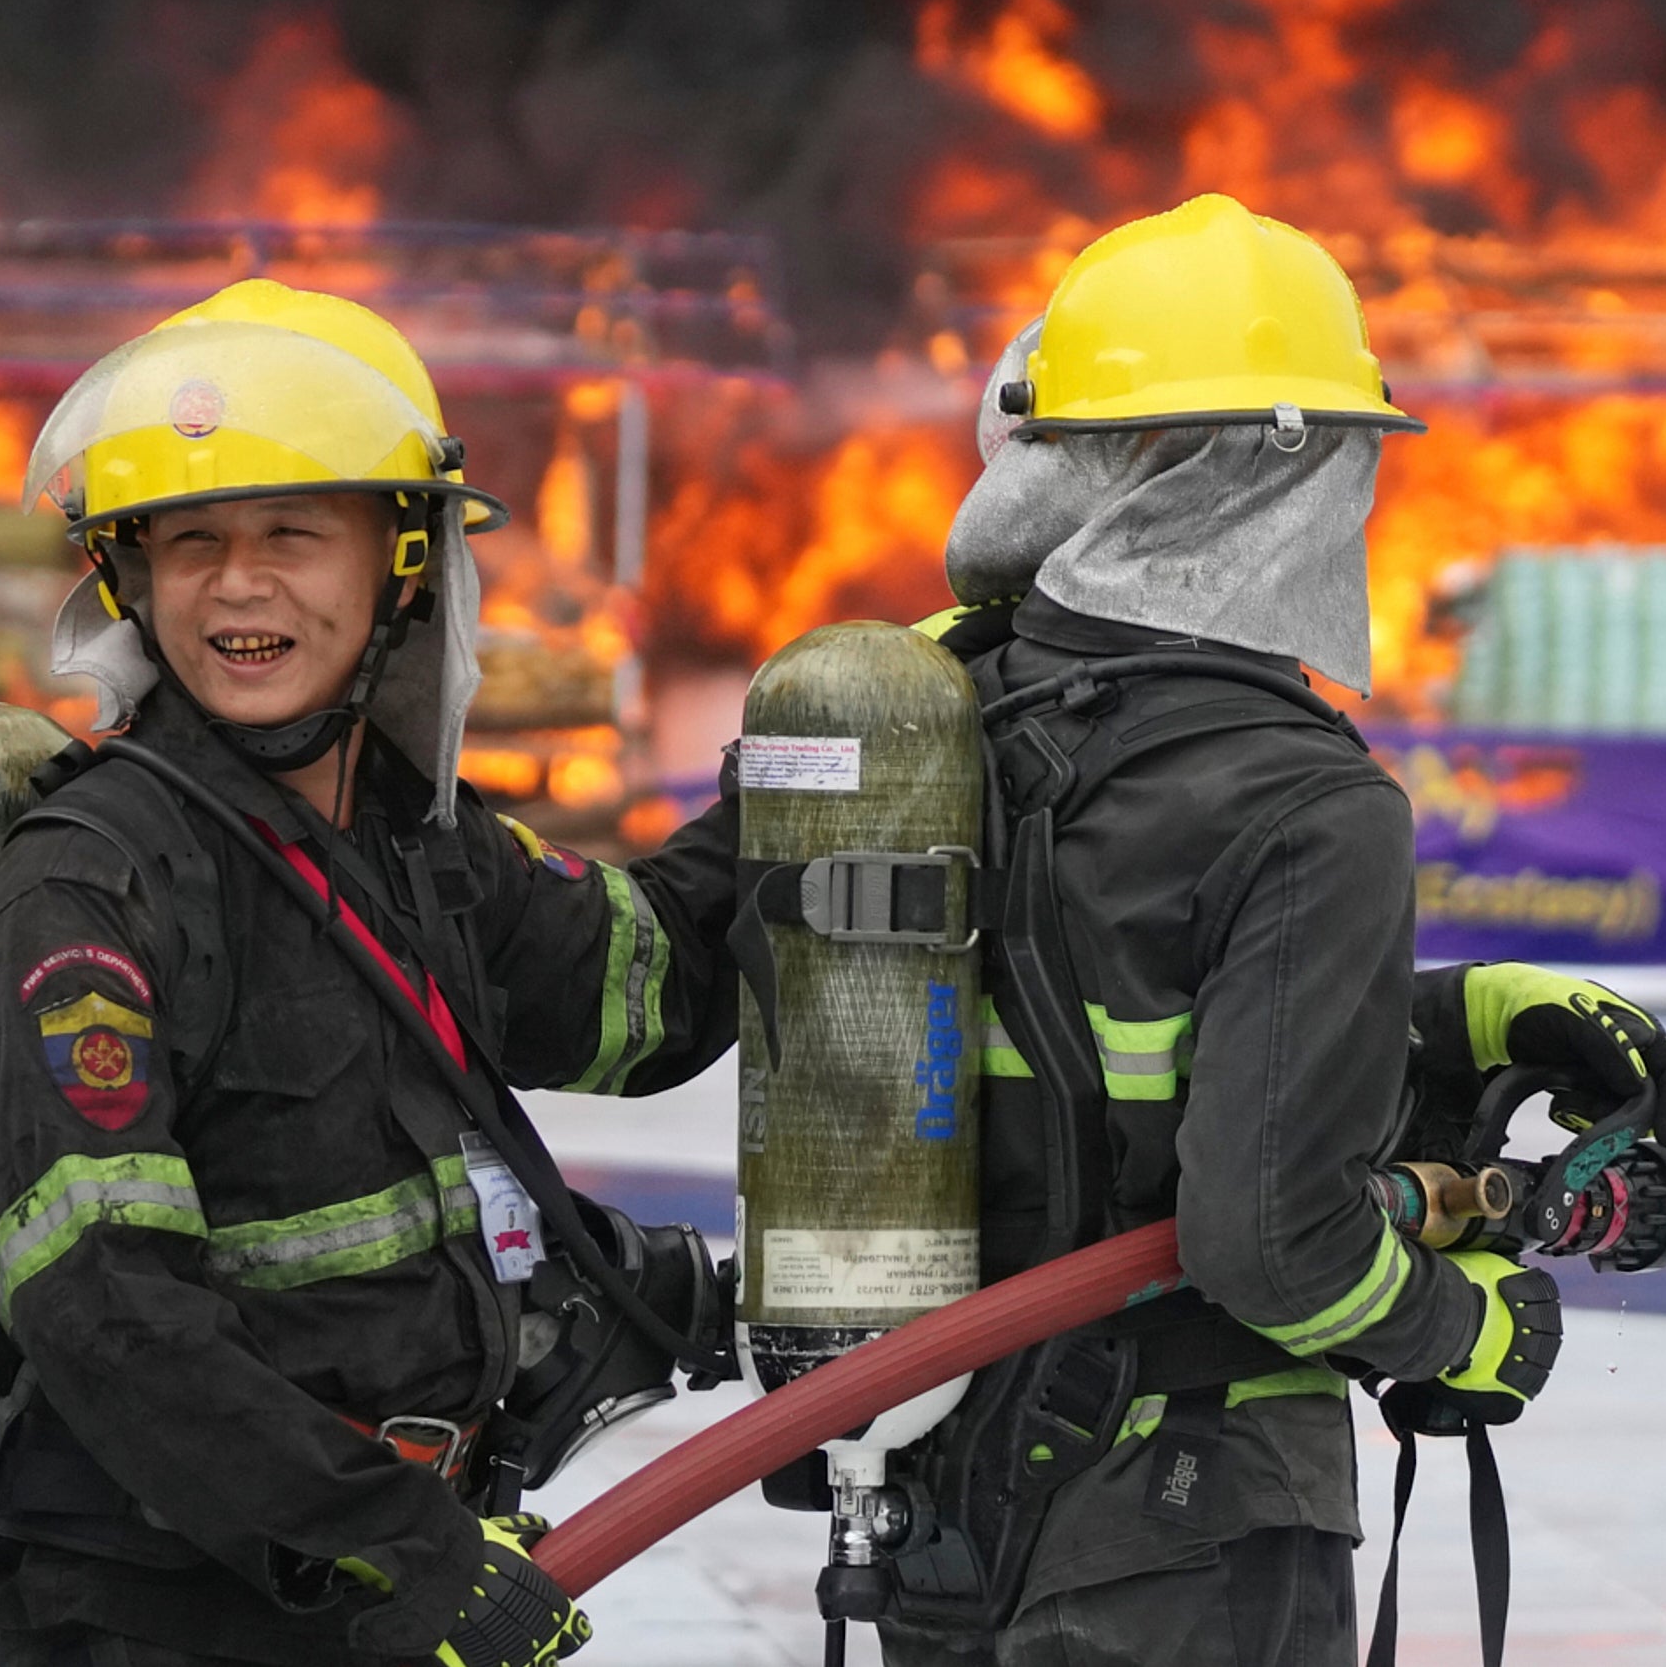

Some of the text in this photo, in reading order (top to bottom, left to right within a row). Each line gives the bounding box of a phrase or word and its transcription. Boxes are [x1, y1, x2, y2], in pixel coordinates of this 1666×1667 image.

[23, 966, 44, 991] FIRE
[96, 949, 150, 998] DEPARTMENT
[916, 977, 963, 1140] Dräger
[740, 1066, 767, 1155] ISN
[1161, 1450, 1198, 1507] Dräger
